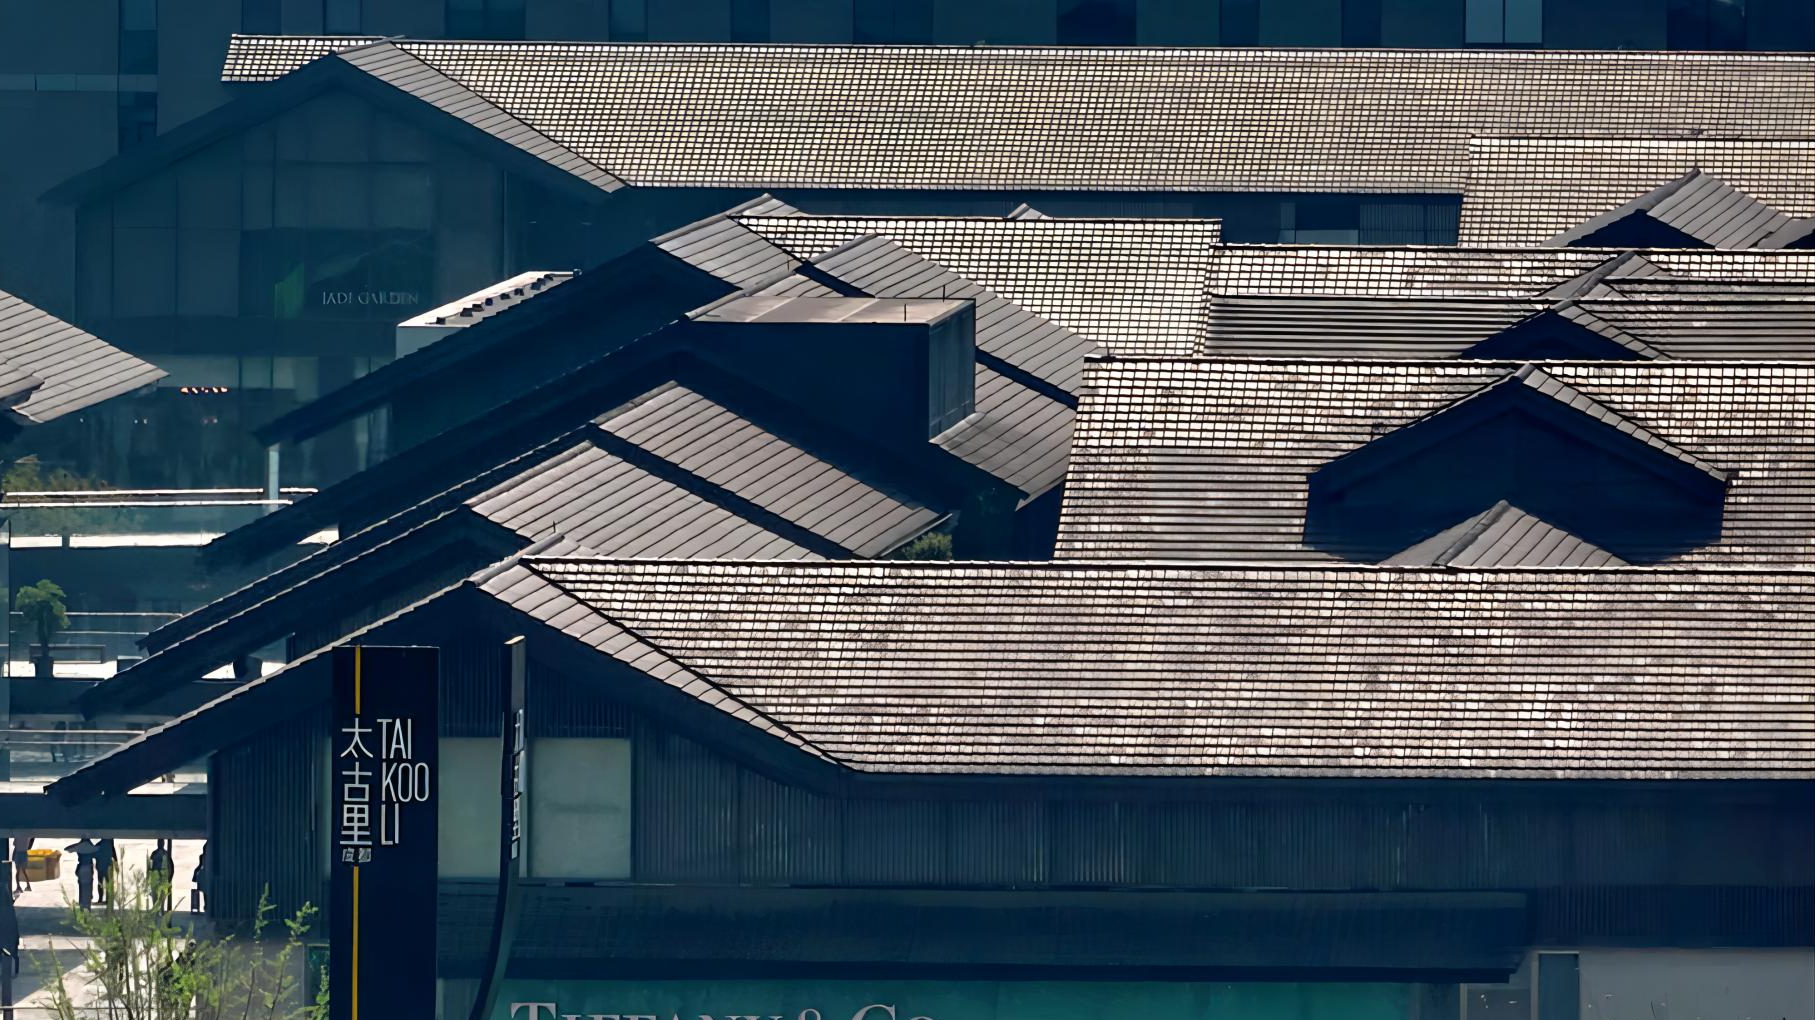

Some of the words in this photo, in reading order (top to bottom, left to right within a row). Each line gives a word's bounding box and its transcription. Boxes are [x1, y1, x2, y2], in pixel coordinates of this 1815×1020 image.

[376, 718, 412, 759] TAI
[340, 717, 373, 845] 太古里
[381, 762, 430, 803] KOO
[380, 803, 400, 845] LI
